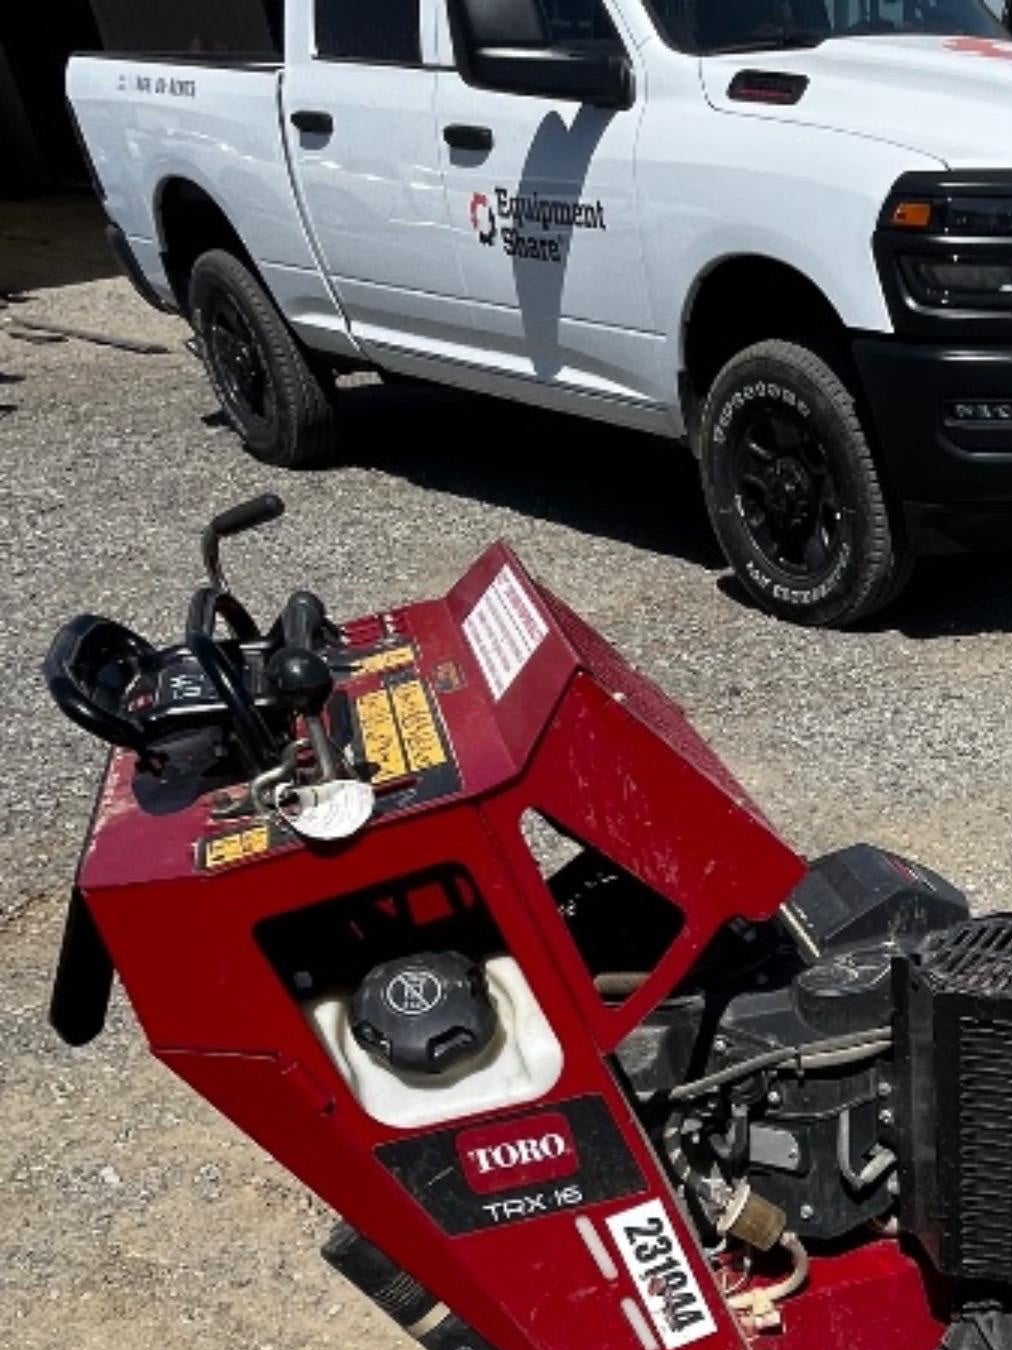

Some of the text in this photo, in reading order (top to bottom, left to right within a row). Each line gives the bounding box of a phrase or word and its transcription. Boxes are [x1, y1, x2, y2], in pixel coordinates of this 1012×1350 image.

[494, 186, 606, 231] Equipment
[501, 227, 561, 262] Share
[467, 1133, 566, 1174] TORO
